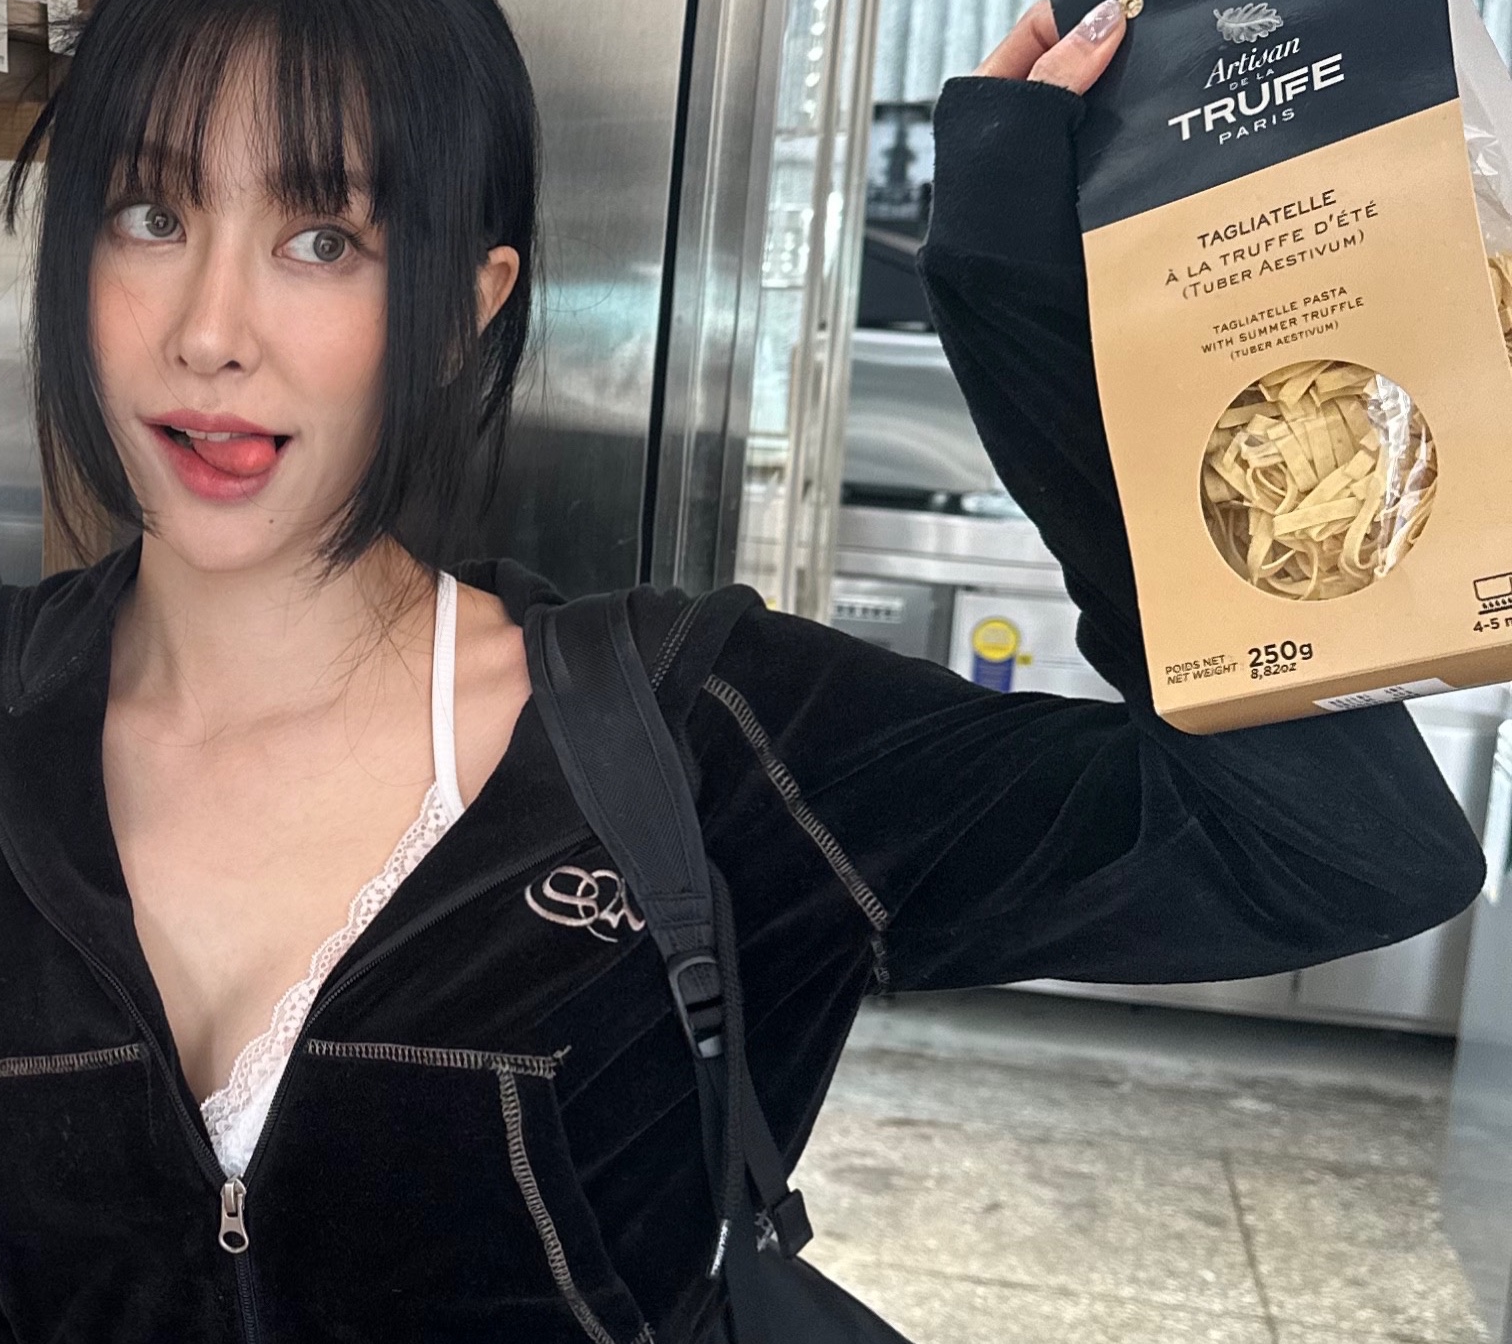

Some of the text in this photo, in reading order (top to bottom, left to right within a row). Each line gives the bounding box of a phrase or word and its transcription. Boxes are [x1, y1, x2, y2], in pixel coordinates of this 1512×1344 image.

[1203, 37, 1302, 90] Artisan
[1229, 68, 1275, 91] DE LA
[1167, 52, 1346, 143] TRUFFE
[1218, 107, 1296, 145] PARIS
[1196, 188, 1338, 251] TAGLIATELLE
[1164, 199, 1379, 286] À LA TRUFFE D'ÉTÉ
[1181, 228, 1367, 302] (TUBER AESTIVUM)
[1200, 296, 1366, 355] WITH SUMMER TRUFFLE
[1211, 285, 1349, 336] TAGLIATELLE PASTA
[1230, 319, 1341, 362] (TUBER AESTIVUM)
[1472, 616, 1501, 633] 4-5
[1164, 654, 1226, 676] POIDS NET
[1166, 662, 1240, 686] NET WEIGHT
[1247, 640, 1315, 668] 250g
[1249, 662, 1298, 681] 8,82oz
